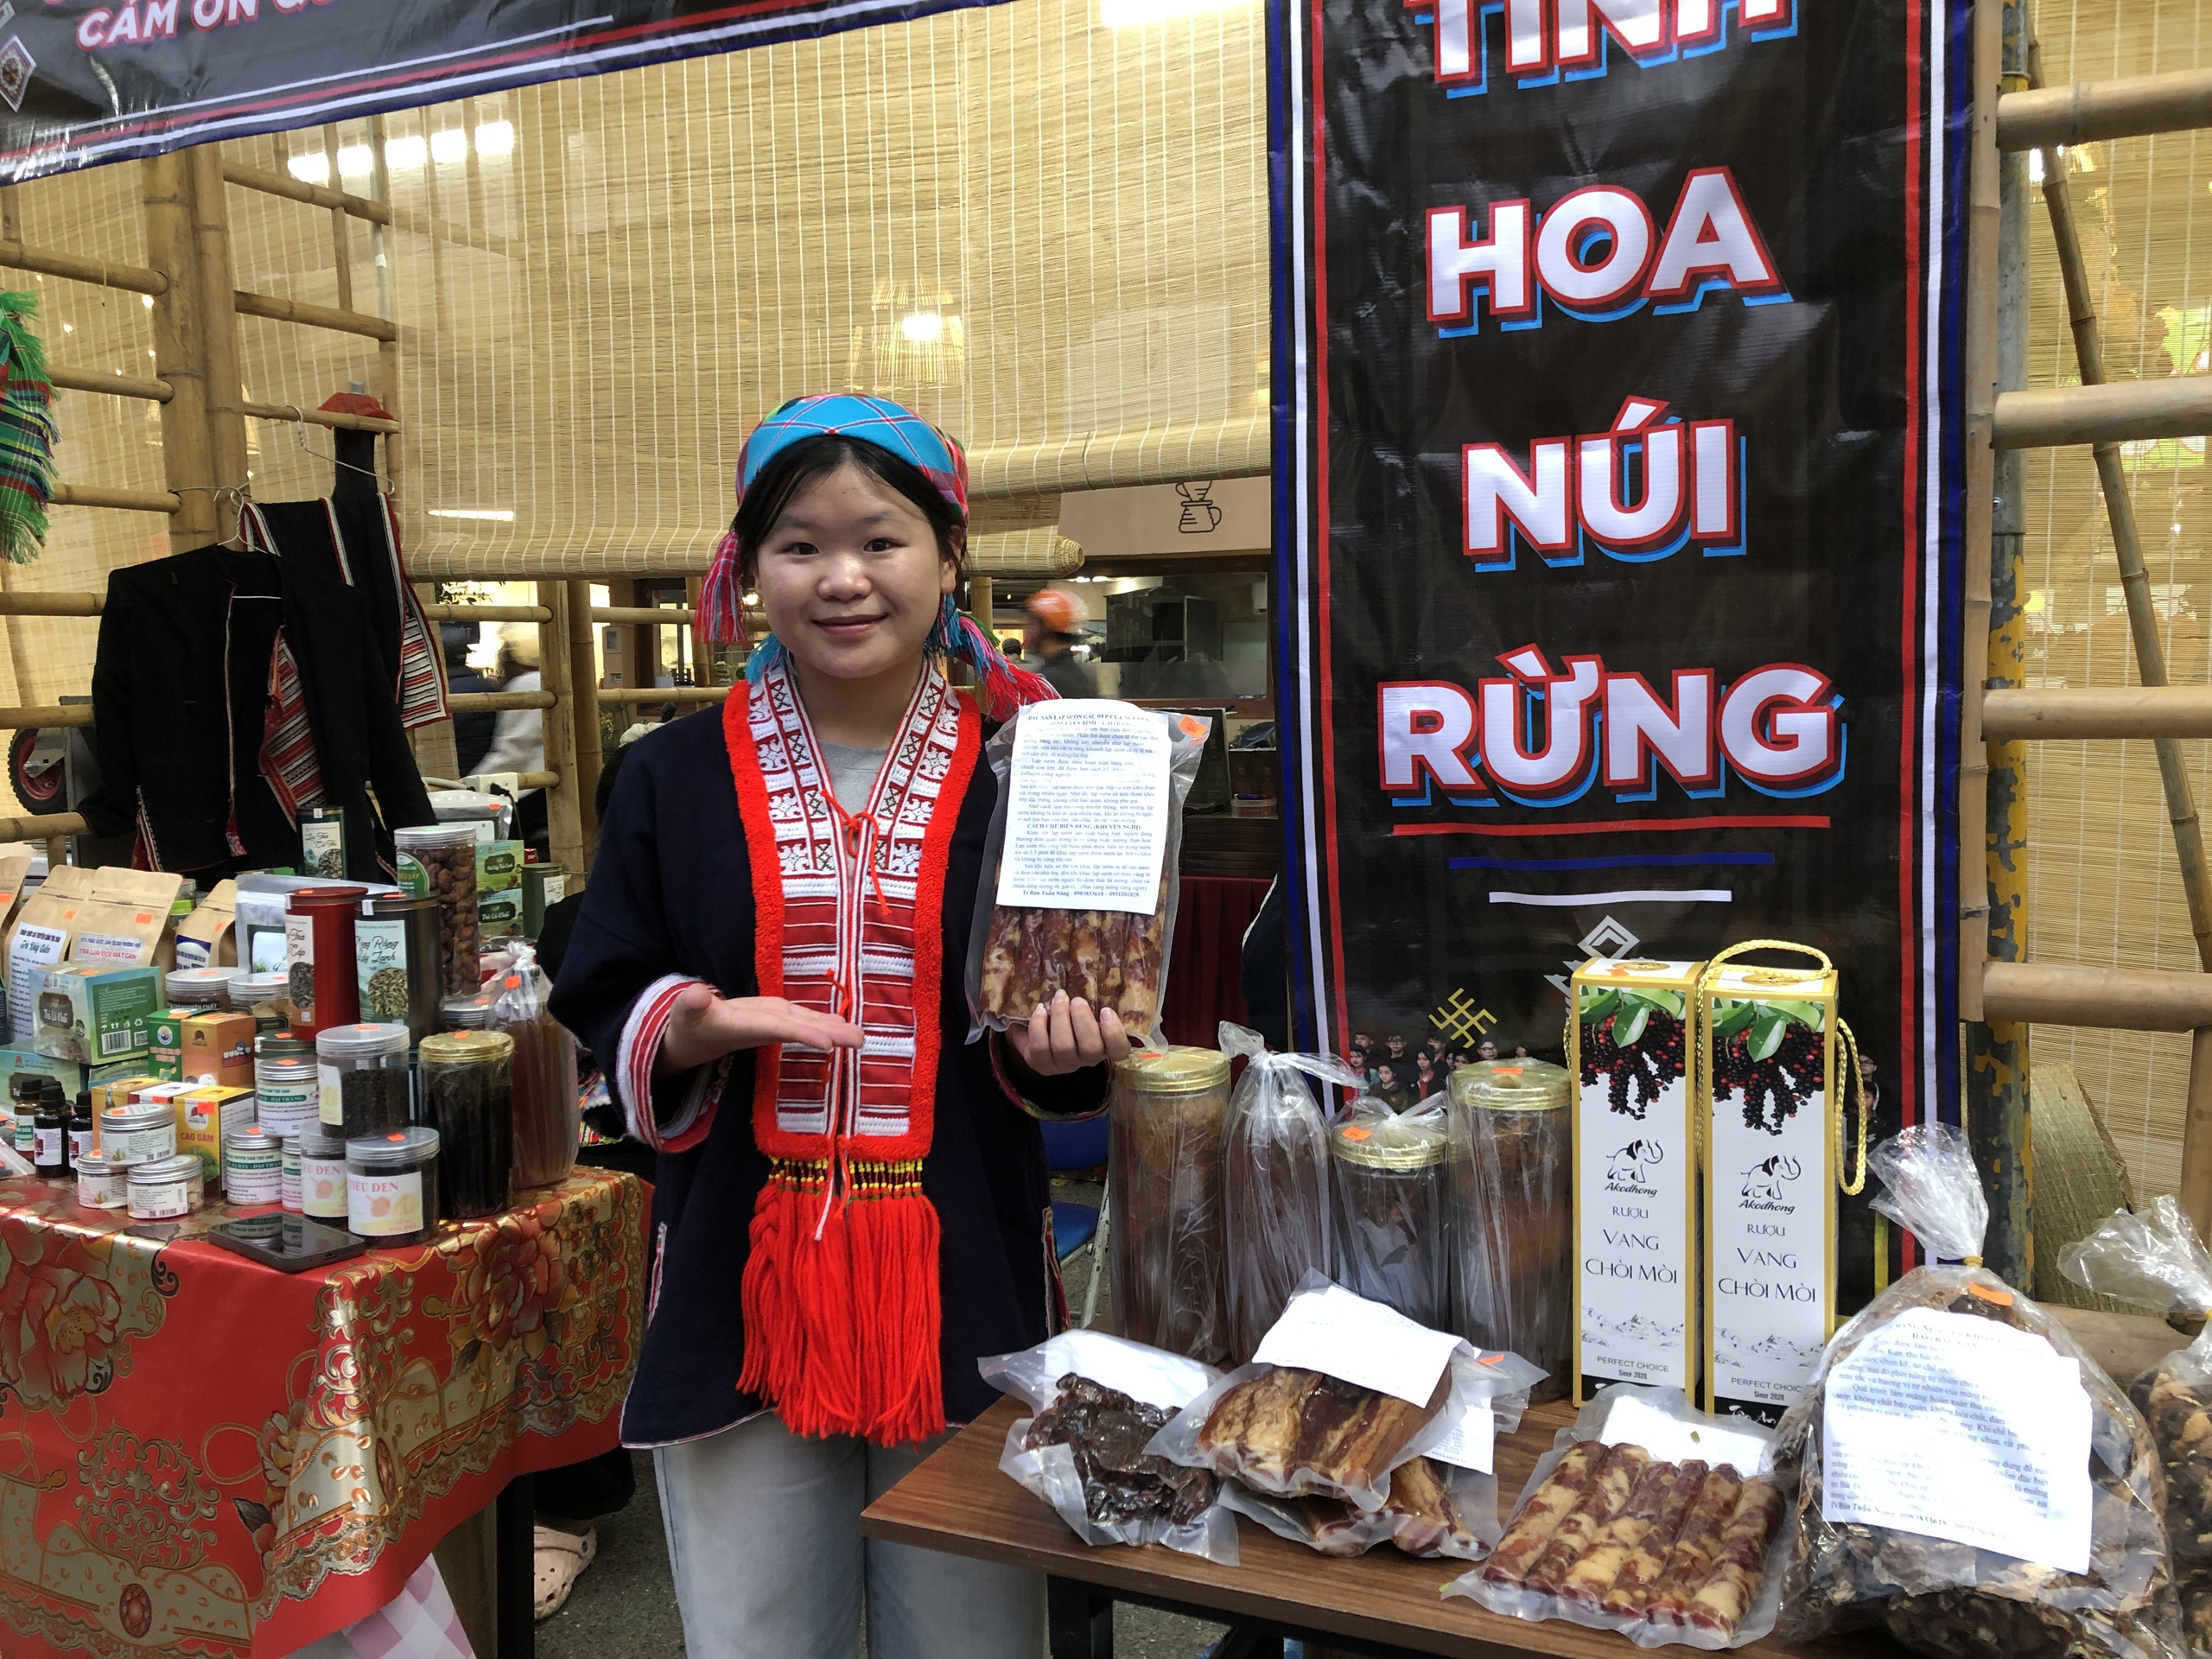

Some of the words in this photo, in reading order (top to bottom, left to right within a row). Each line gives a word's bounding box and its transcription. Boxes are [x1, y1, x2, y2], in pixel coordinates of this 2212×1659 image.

[1427, 166, 1789, 328] HOA
[1462, 395, 1743, 560] NÚI
[1378, 644, 1841, 798] RỪNG
[315, 1164, 340, 1175] ĐEN
[372, 1182, 398, 1193] ĐEN
[1605, 1182, 1657, 1198] Akodhong
[1612, 1206, 1649, 1219] RƯỢU
[1738, 1199, 1796, 1215] Akodhong
[1747, 1224, 1786, 1236] RƯỢU
[1603, 1229, 1659, 1250] VANG
[1737, 1248, 1797, 1269] VANG
[1586, 1258, 1632, 1279] CHÒI
[1639, 1263, 1677, 1284] MÒI
[1719, 1278, 1769, 1298] CHÒI
[1775, 1282, 1815, 1303] MÒI
[1597, 1356, 1635, 1368] PERFECT
[1637, 1362, 1669, 1372] CHOICE
[1634, 1371, 1648, 1380] 2020
[1731, 1377, 1771, 1389] PERFECT
[1773, 1382, 1802, 1393] CHOIC
[1754, 1390, 1769, 1399] Since
[1770, 1392, 1785, 1401] 2020
